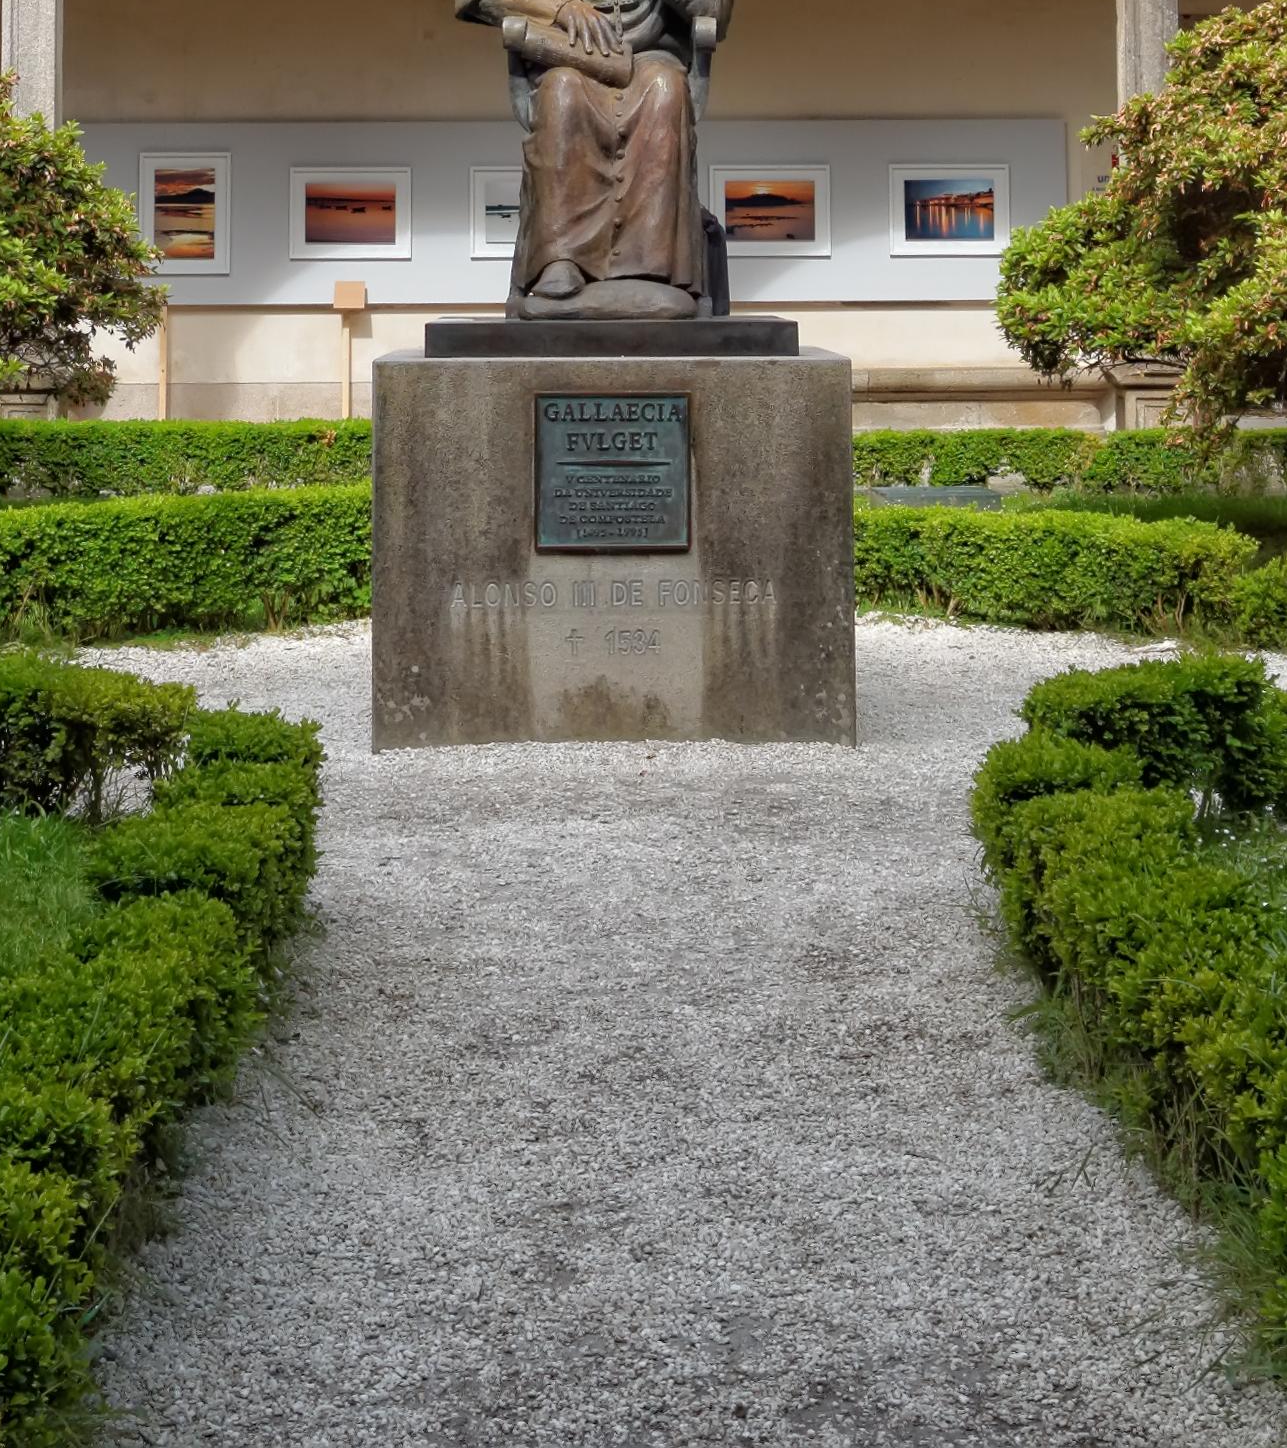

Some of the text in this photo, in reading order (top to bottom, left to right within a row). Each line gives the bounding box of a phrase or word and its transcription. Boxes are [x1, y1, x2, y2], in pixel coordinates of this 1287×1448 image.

[544, 403, 684, 422] GALLAECIA
[567, 432, 658, 451] FVLGET
[574, 488, 674, 498] UNIVERSIDADE
[590, 501, 657, 511] SANTIAGO
[579, 514, 666, 525] COMPOSTELA
[450, 581, 557, 608] ALONSO
[610, 579, 644, 607] DE
[658, 578, 777, 606] FONSECA
[604, 627, 661, 656] 1534
